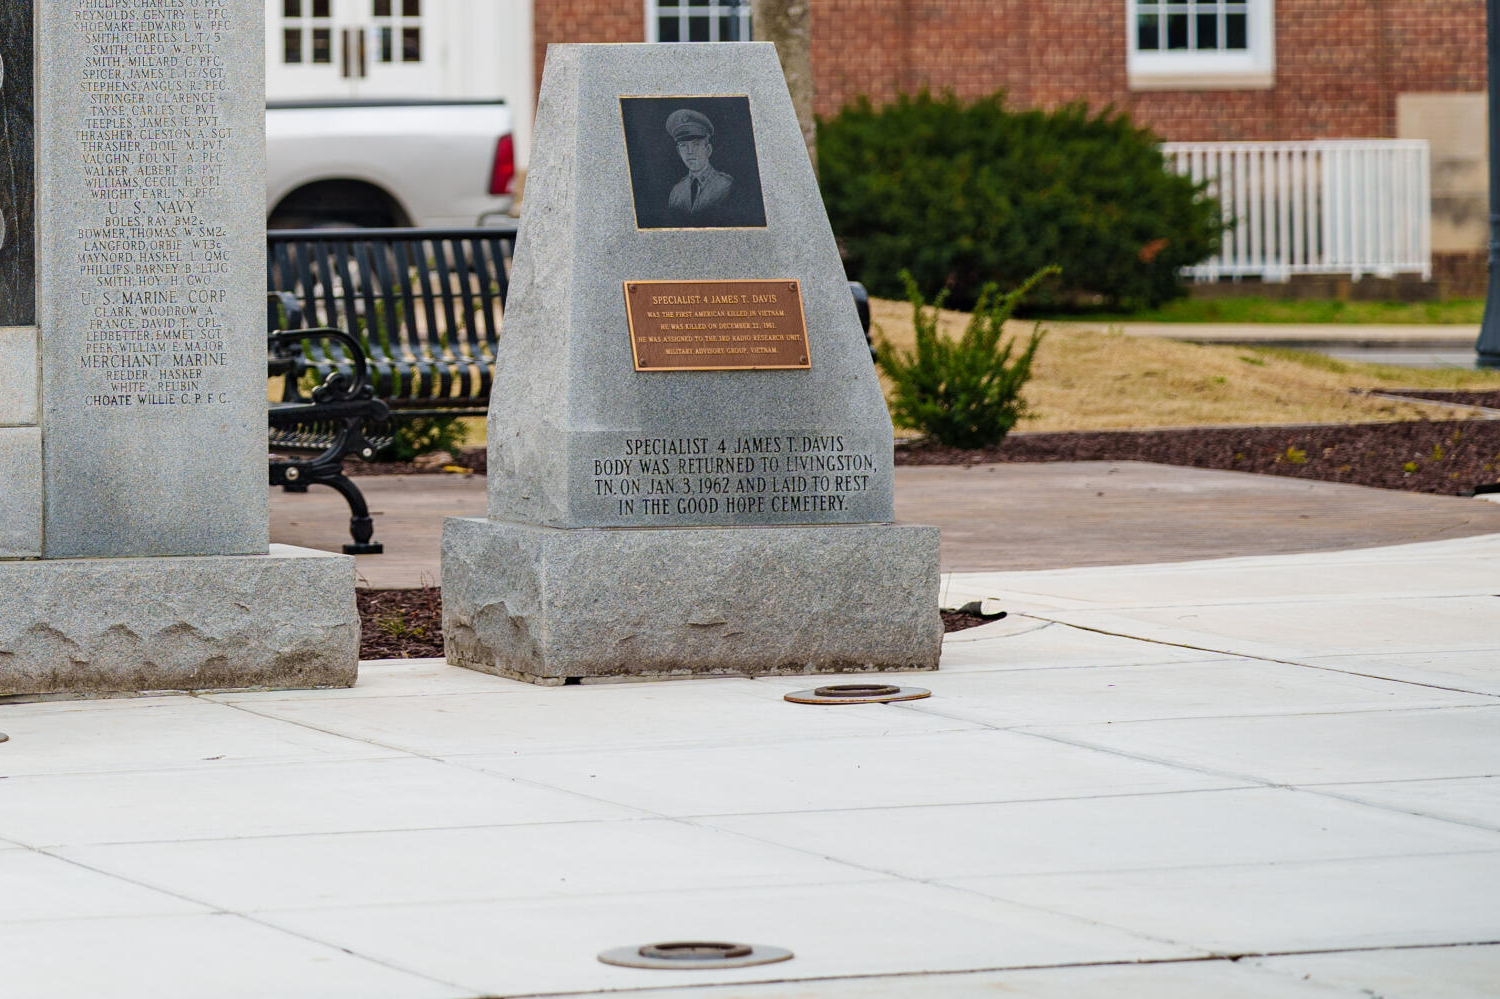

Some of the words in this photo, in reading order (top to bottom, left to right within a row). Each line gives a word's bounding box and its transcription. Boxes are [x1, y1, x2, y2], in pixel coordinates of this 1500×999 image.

[122, 291, 176, 305] MARINE
[652, 296, 700, 304] SPECIALIST
[711, 295, 738, 304] JAMES
[741, 295, 750, 303] T.
[753, 295, 777, 303] DAVIS
[81, 354, 161, 369] MERCHANT
[173, 353, 228, 367] MARINE
[626, 438, 708, 456] SPECIALIST
[718, 439, 726, 454] 4
[734, 437, 780, 454] JAMES
[786, 437, 798, 452] T.
[803, 436, 844, 452] DAVIS
[595, 459, 632, 476] BODY
[640, 459, 669, 475] WAS
[679, 457, 754, 475] RETURNED
[760, 456, 779, 473] TO
[786, 454, 877, 473] LIVINGSTON,
[595, 480, 617, 496] TN.
[620, 479, 641, 495] ON
[647, 478, 678, 495] JAN.
[683, 478, 696, 496] 3,
[699, 477, 730, 494] 1962
[736, 477, 766, 493] AND
[772, 476, 807, 492] LAID
[811, 476, 829, 492] TO
[835, 475, 869, 491] REST
[618, 500, 634, 516] IN
[644, 499, 670, 515] THE
[678, 498, 719, 514] GOOD
[726, 497, 764, 513] HOPE
[772, 495, 848, 512] CEMETERY.
